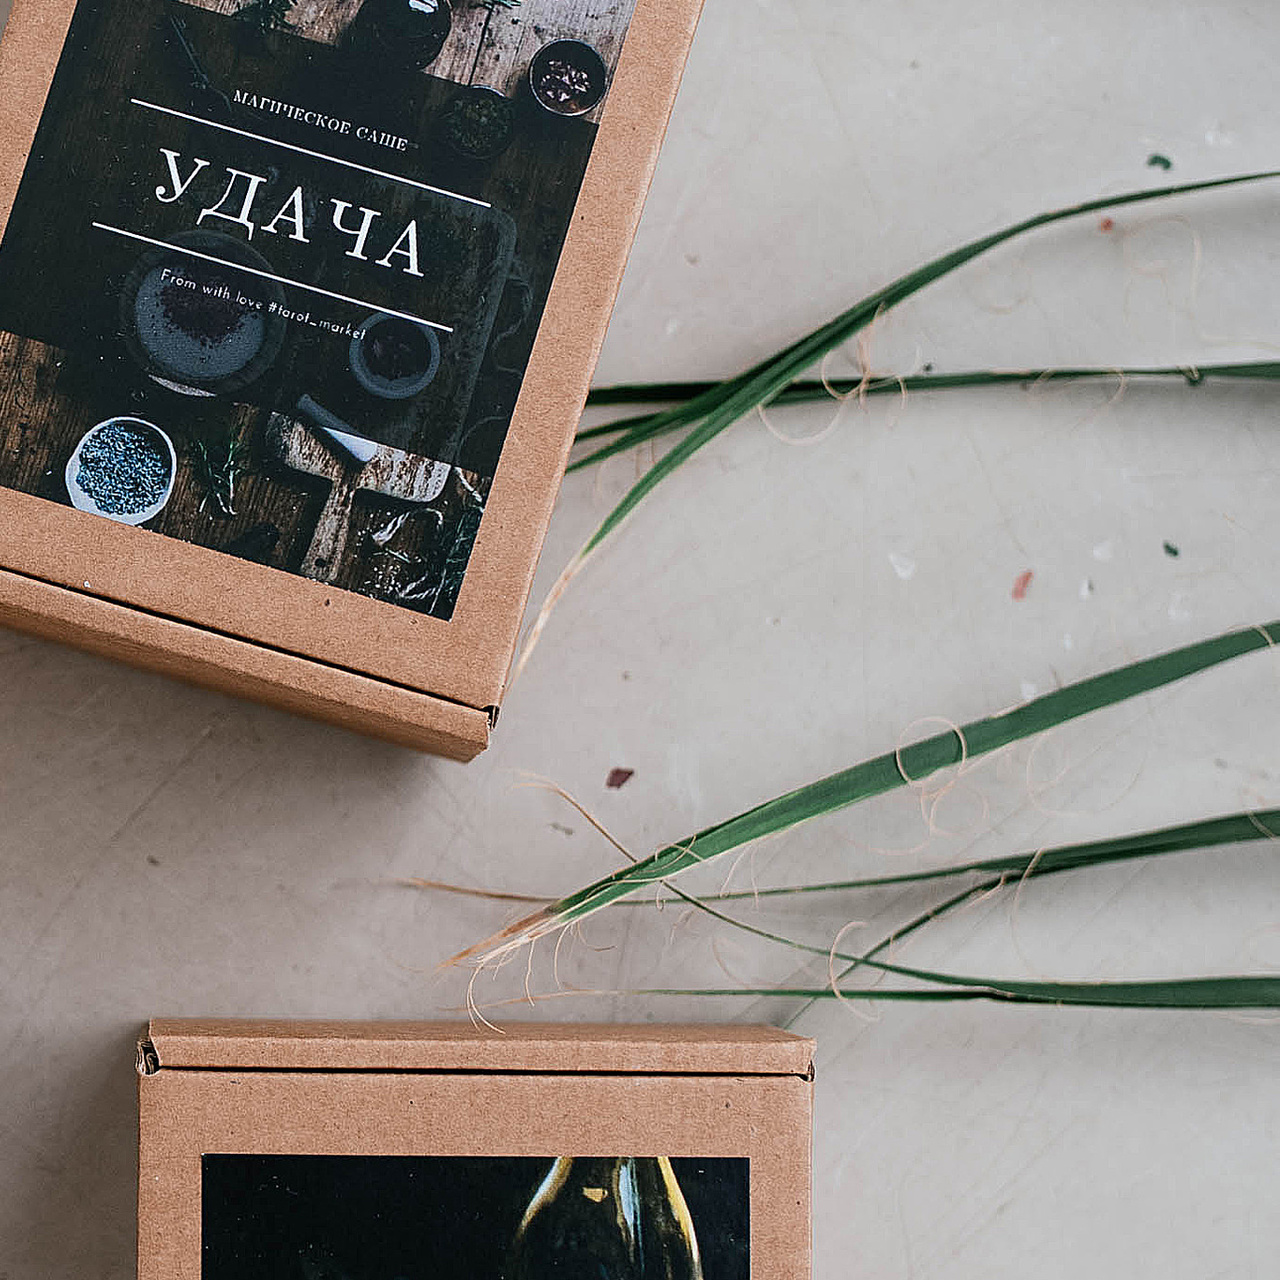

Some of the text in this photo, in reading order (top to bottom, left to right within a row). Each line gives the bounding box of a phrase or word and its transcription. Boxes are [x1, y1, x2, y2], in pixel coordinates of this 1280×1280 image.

[233, 89, 409, 152] МАГИЧЕСКОЕ САШЕ
[154, 148, 424, 277] УДАЧА
[160, 269, 197, 291] From
[201, 281, 231, 301] with
[235, 291, 264, 311] love
